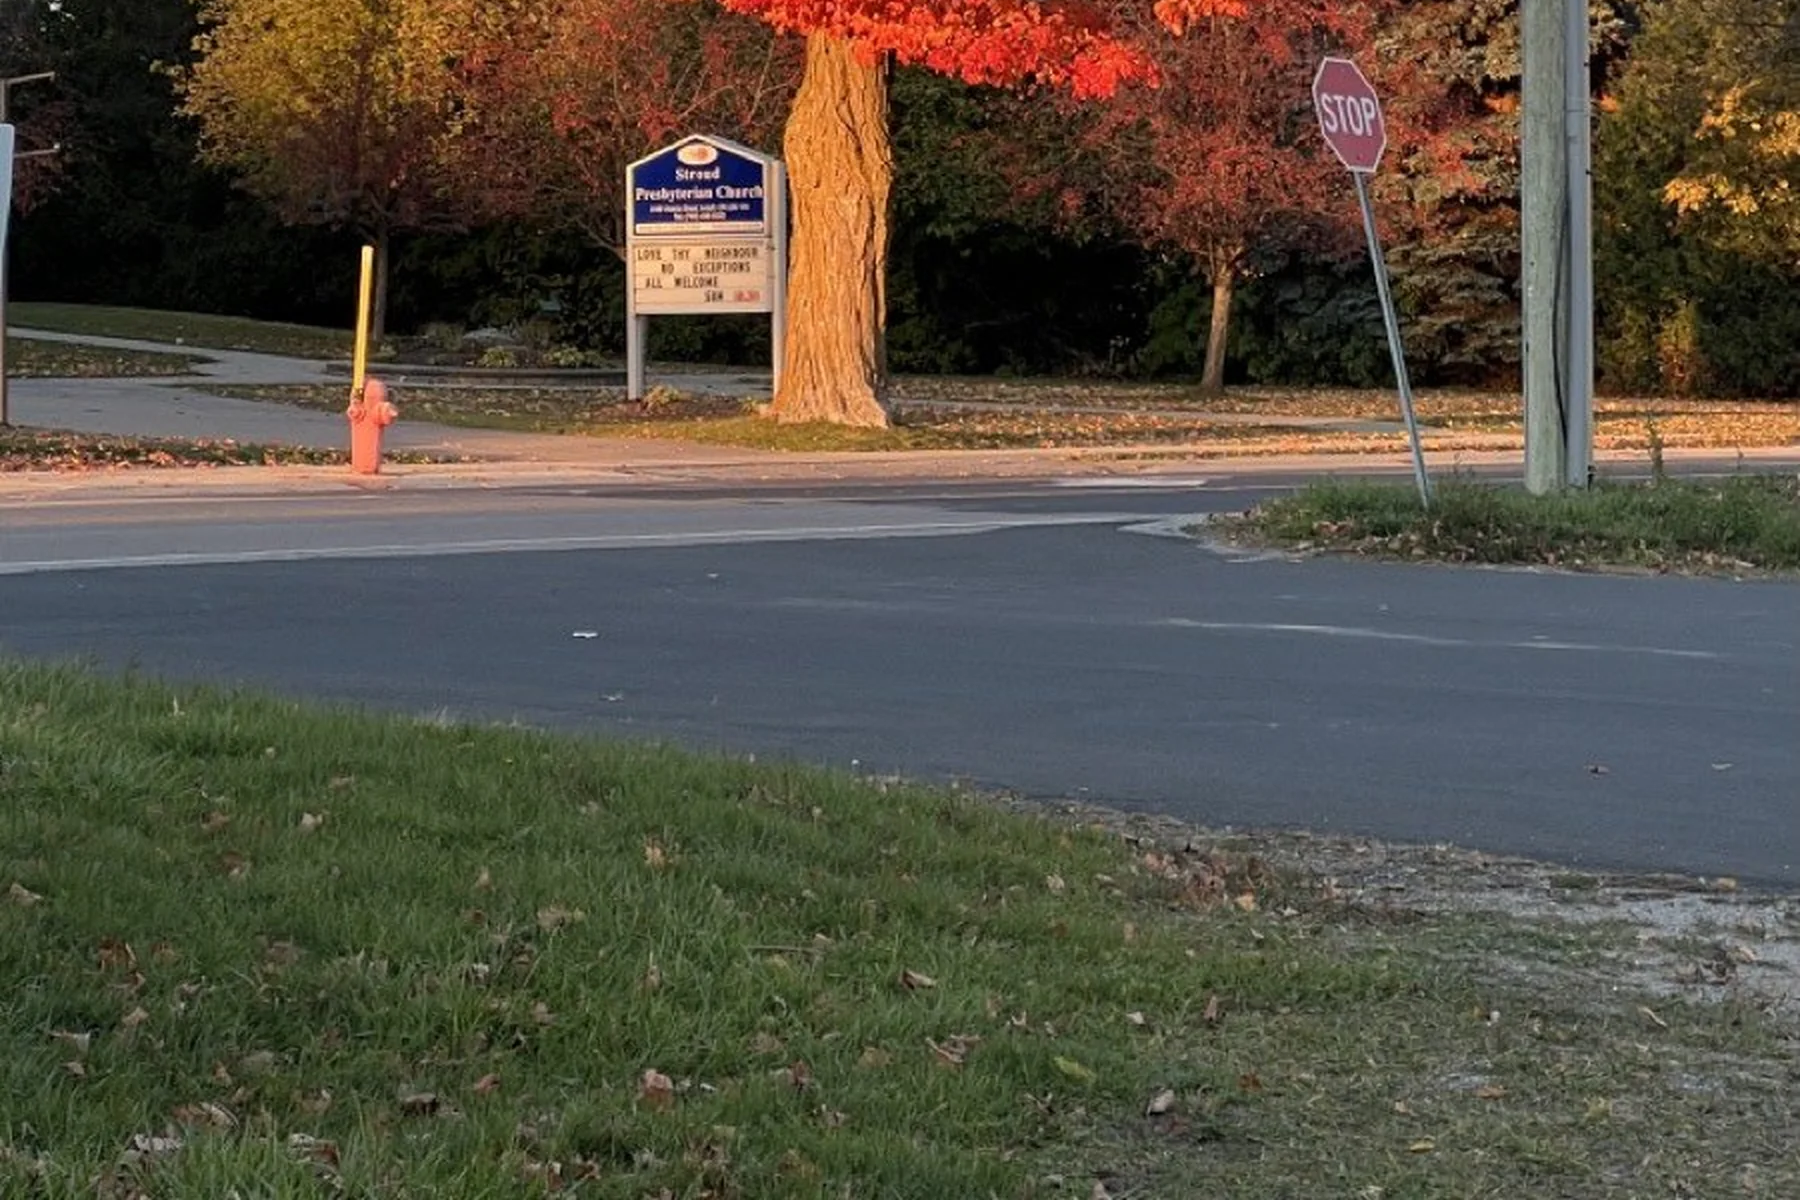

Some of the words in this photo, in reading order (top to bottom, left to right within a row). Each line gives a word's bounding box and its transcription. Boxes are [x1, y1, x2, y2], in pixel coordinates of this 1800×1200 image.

[1321, 93, 1376, 137] STOP
[675, 166, 721, 181] Stroud
[636, 185, 713, 202] Presbyterian
[715, 185, 763, 199] Church
[637, 249, 662, 261] LOVE
[672, 248, 690, 260] THY
[704, 247, 758, 259] NEIGHBOUR
[661, 262, 675, 274] NO
[693, 261, 752, 274] EXCEPTIONS
[645, 278, 663, 288] ALL
[674, 276, 719, 288] WELCOME
